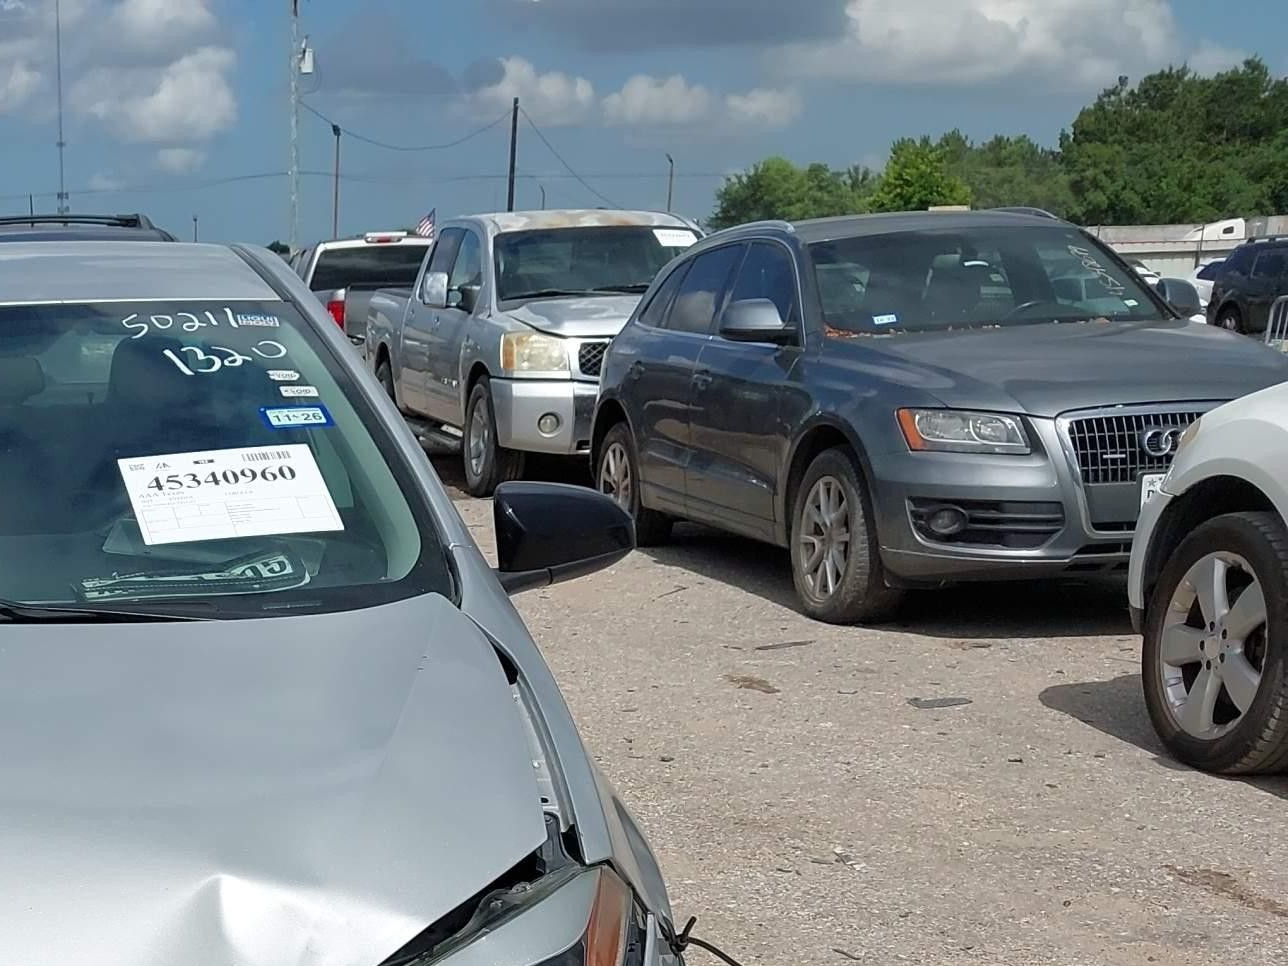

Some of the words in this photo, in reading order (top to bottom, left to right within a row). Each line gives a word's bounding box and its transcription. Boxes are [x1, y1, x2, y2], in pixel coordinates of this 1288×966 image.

[122, 308, 239, 339] 50211
[163, 340, 287, 376] 1320
[147, 465, 297, 491] 45340960
